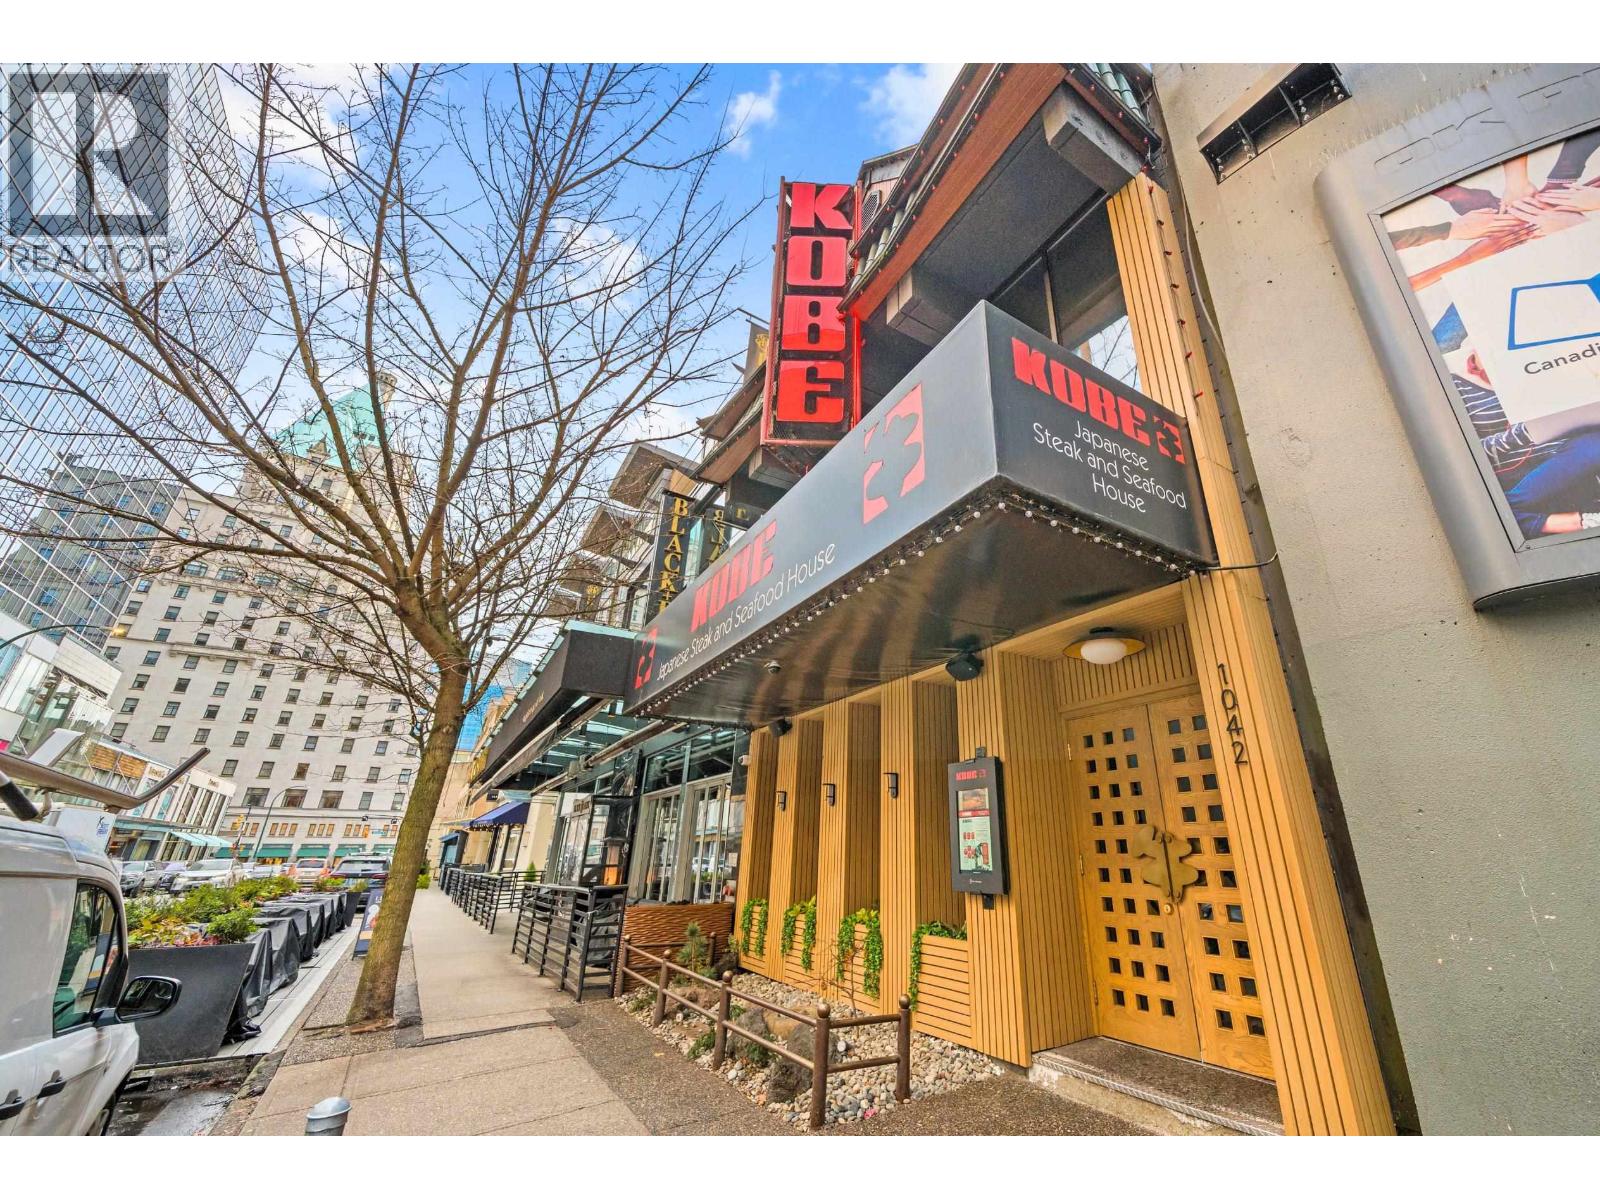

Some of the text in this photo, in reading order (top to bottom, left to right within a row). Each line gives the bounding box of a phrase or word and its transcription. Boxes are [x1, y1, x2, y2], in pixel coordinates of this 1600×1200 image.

[776, 182, 853, 423] KOBE
[1012, 337, 1150, 446] KOBE
[1033, 422, 1187, 510] Steak and Seafood
[1074, 420, 1149, 471] Japanese
[1093, 473, 1146, 513] House
[657, 543, 836, 681] Japanese Steak and Seafood House
[689, 519, 777, 633] KOBE
[1218, 663, 1248, 764] 1042
